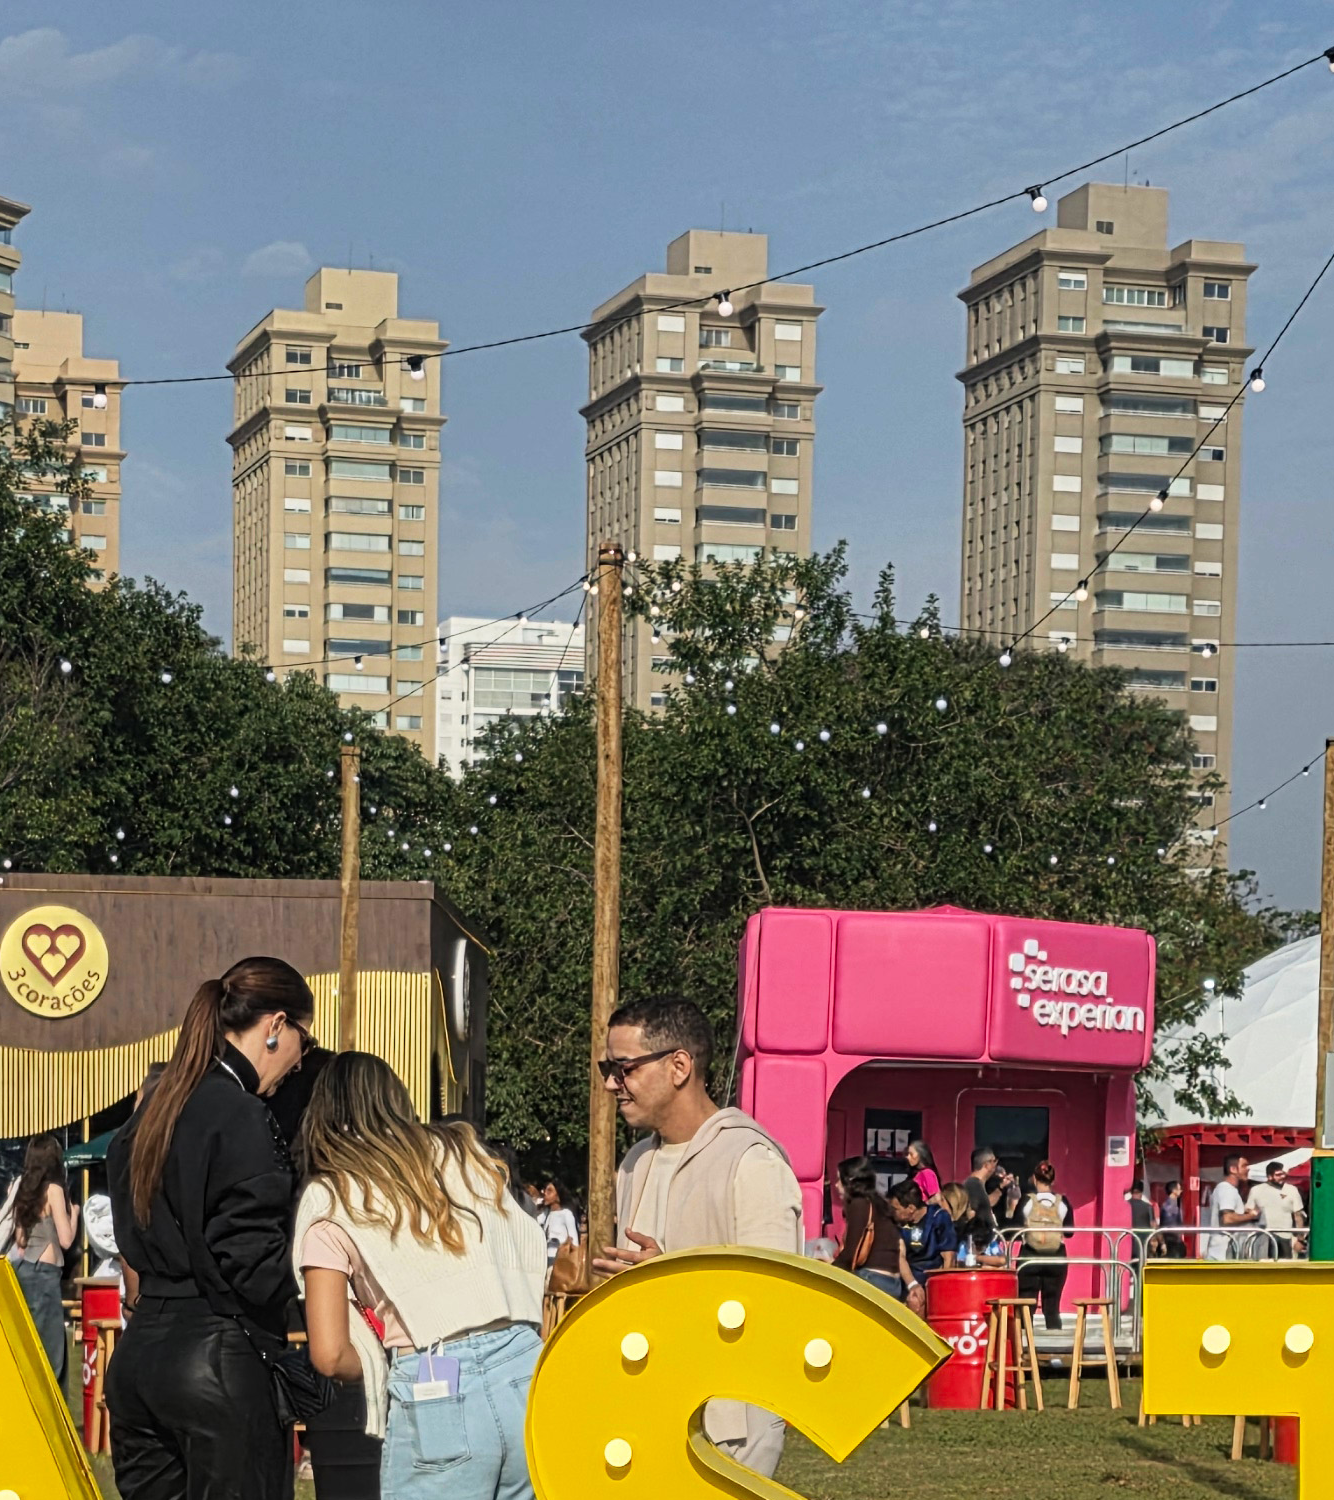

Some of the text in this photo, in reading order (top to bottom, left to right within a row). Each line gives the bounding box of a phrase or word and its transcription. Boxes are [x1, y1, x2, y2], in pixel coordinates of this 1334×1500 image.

[7, 967, 101, 1012] 3 corações
[1024, 964, 1108, 996] serasa
[1033, 997, 1145, 1037] experian
